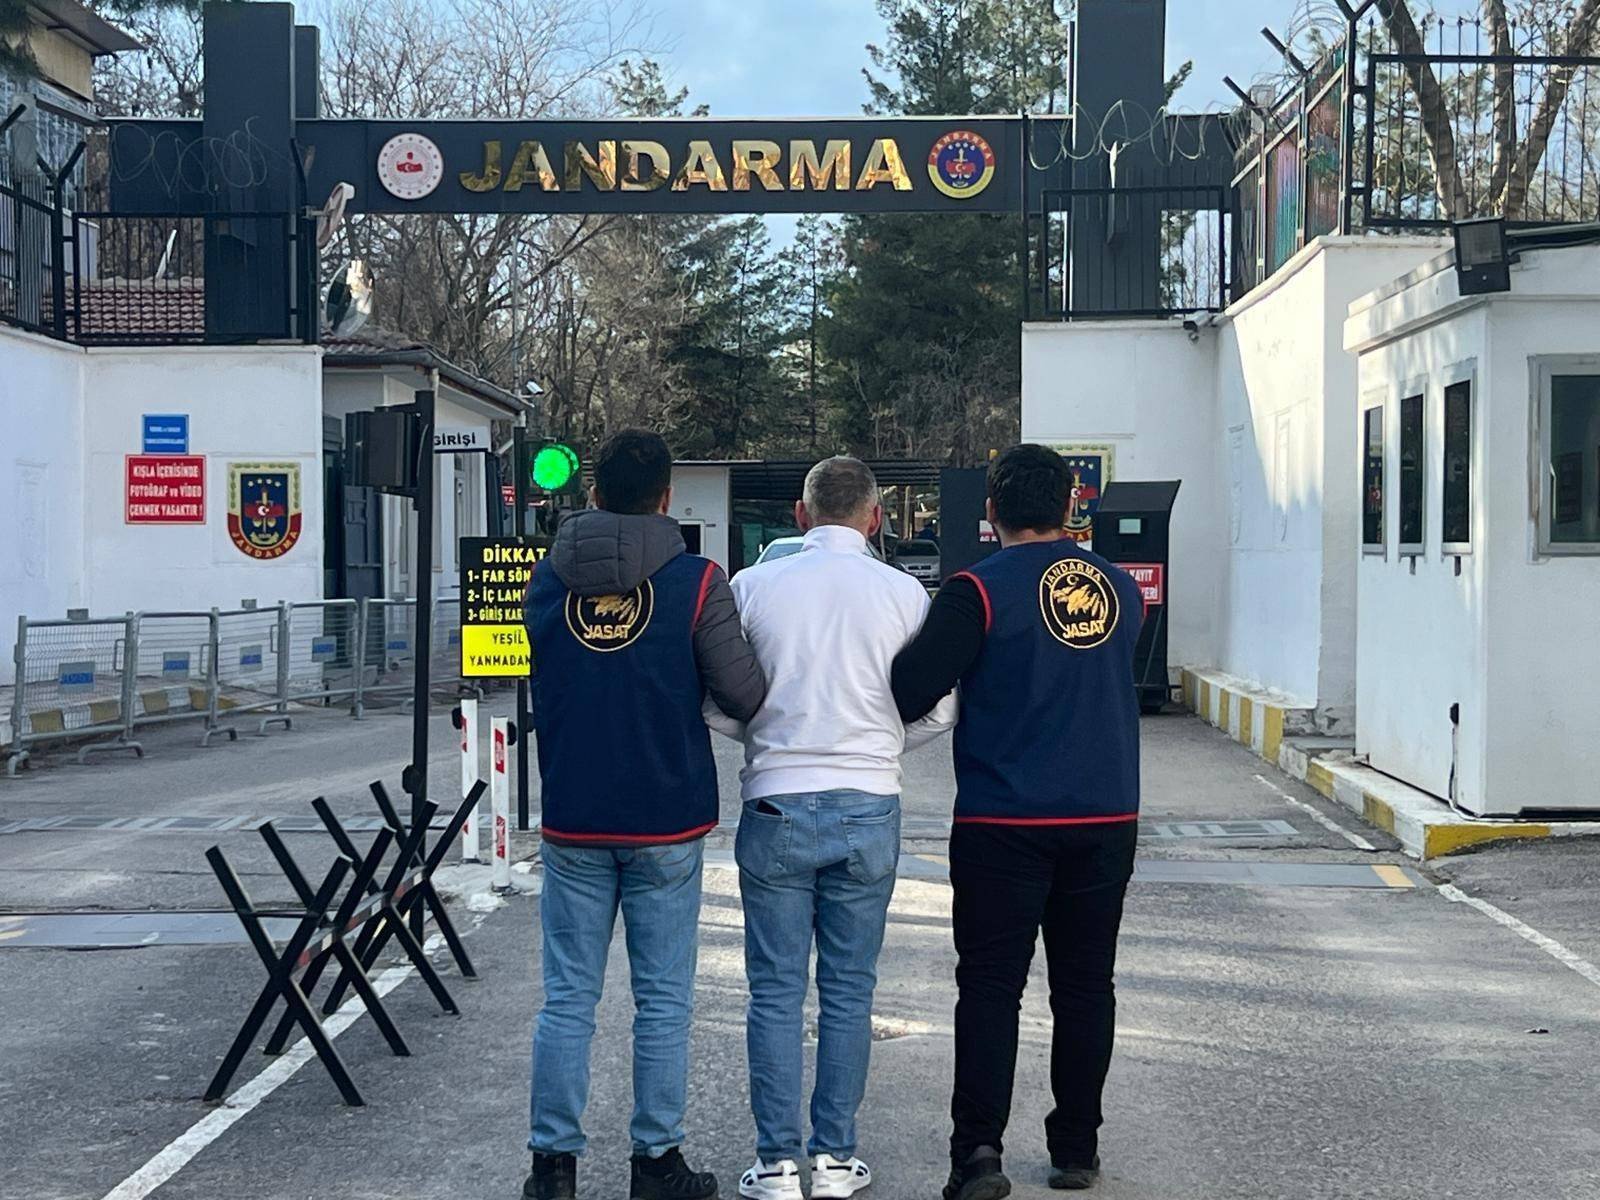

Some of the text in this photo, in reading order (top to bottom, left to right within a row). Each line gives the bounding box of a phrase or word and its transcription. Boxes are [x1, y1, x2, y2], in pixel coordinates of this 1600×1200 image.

[459, 138, 914, 192] JANDARMA
[133, 462, 199, 479] KIŞLA İÇERİSİNDE
[130, 482, 202, 497] FOTOĞRAF ve VİDEO
[130, 503, 160, 517] ÇEKMEK
[231, 531, 298, 558] JANDARMA
[483, 544, 546, 563] DİKKAT
[482, 570, 505, 583] FAR
[1045, 562, 1102, 588] JANDARMA
[482, 586, 494, 603] İÇ
[497, 589, 526, 602] LAM
[480, 605, 503, 622] GİRİŞ
[583, 624, 631, 640] JASAT
[1062, 619, 1107, 639] JASAT
[492, 630, 524, 646] YEŞİL
